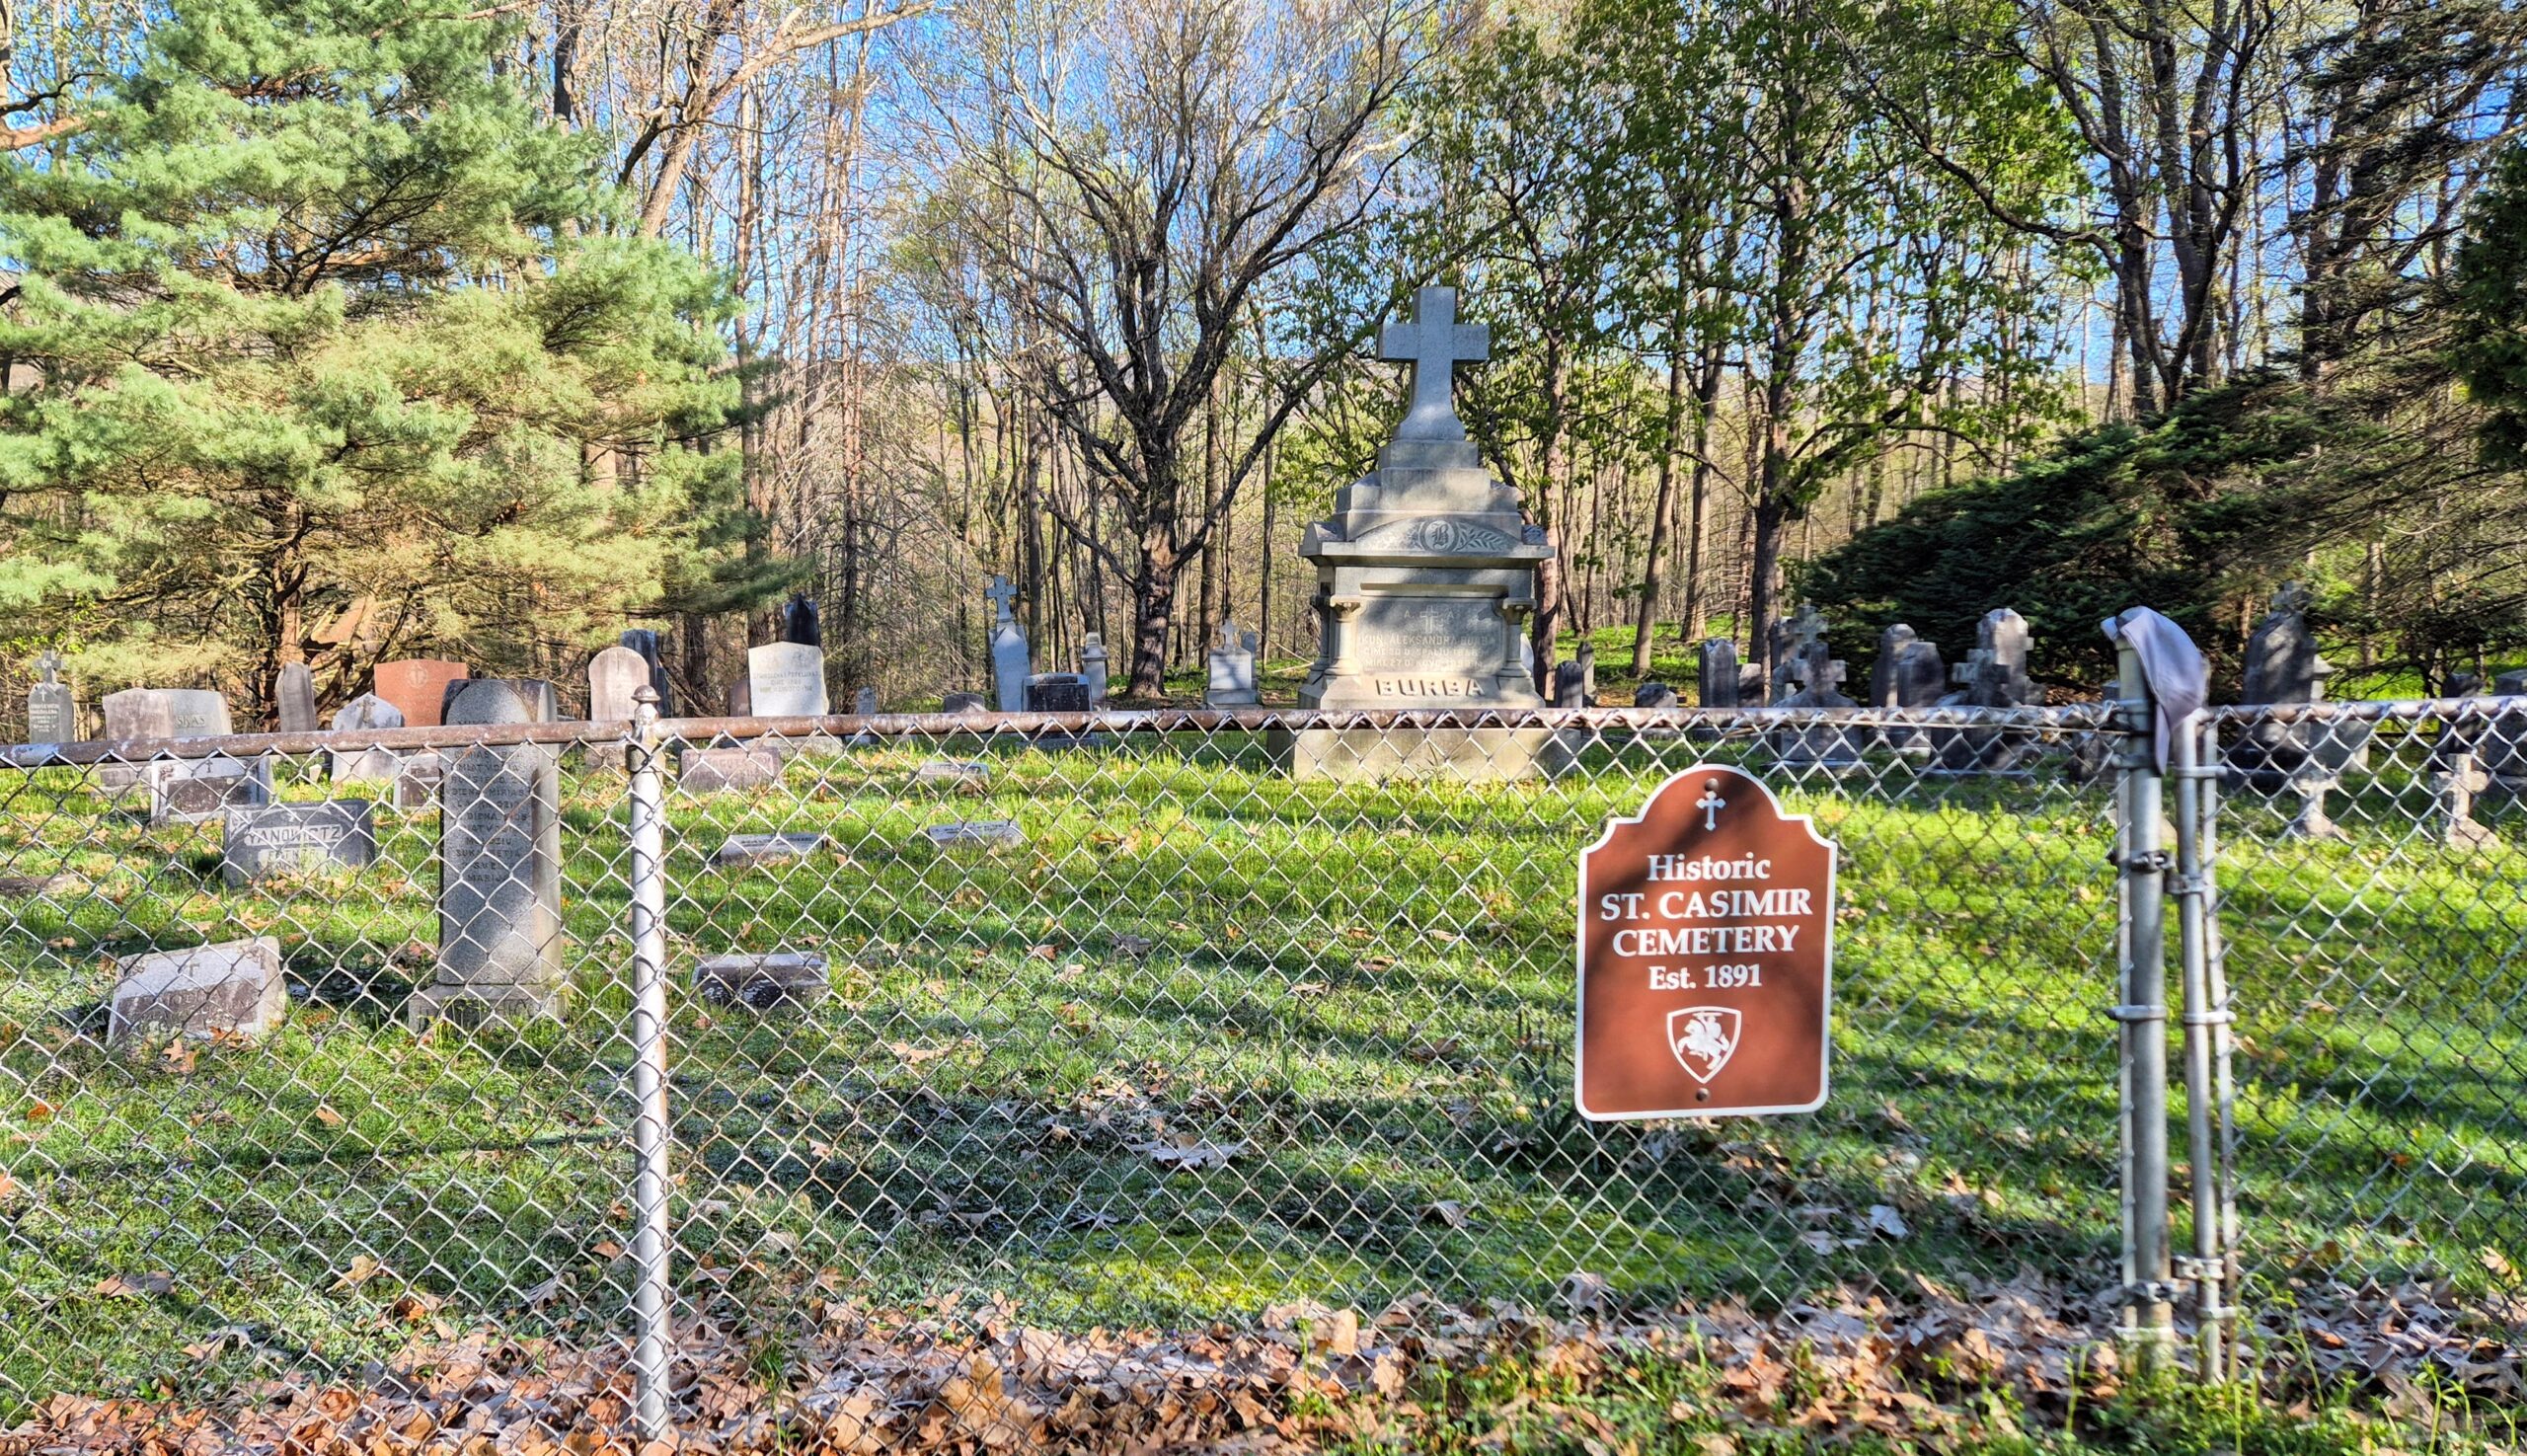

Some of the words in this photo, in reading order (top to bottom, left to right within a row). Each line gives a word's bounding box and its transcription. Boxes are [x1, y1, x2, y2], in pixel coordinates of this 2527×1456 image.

[1375, 679, 1486, 697] BURBA
[1646, 852, 1771, 881] Historic
[1600, 892, 1651, 921] ST.
[1658, 888, 1813, 920] CASIMIR
[1612, 925, 1800, 958] CEMETERY
[1647, 965, 1697, 990] Est.
[1704, 962, 1763, 988] 1891
